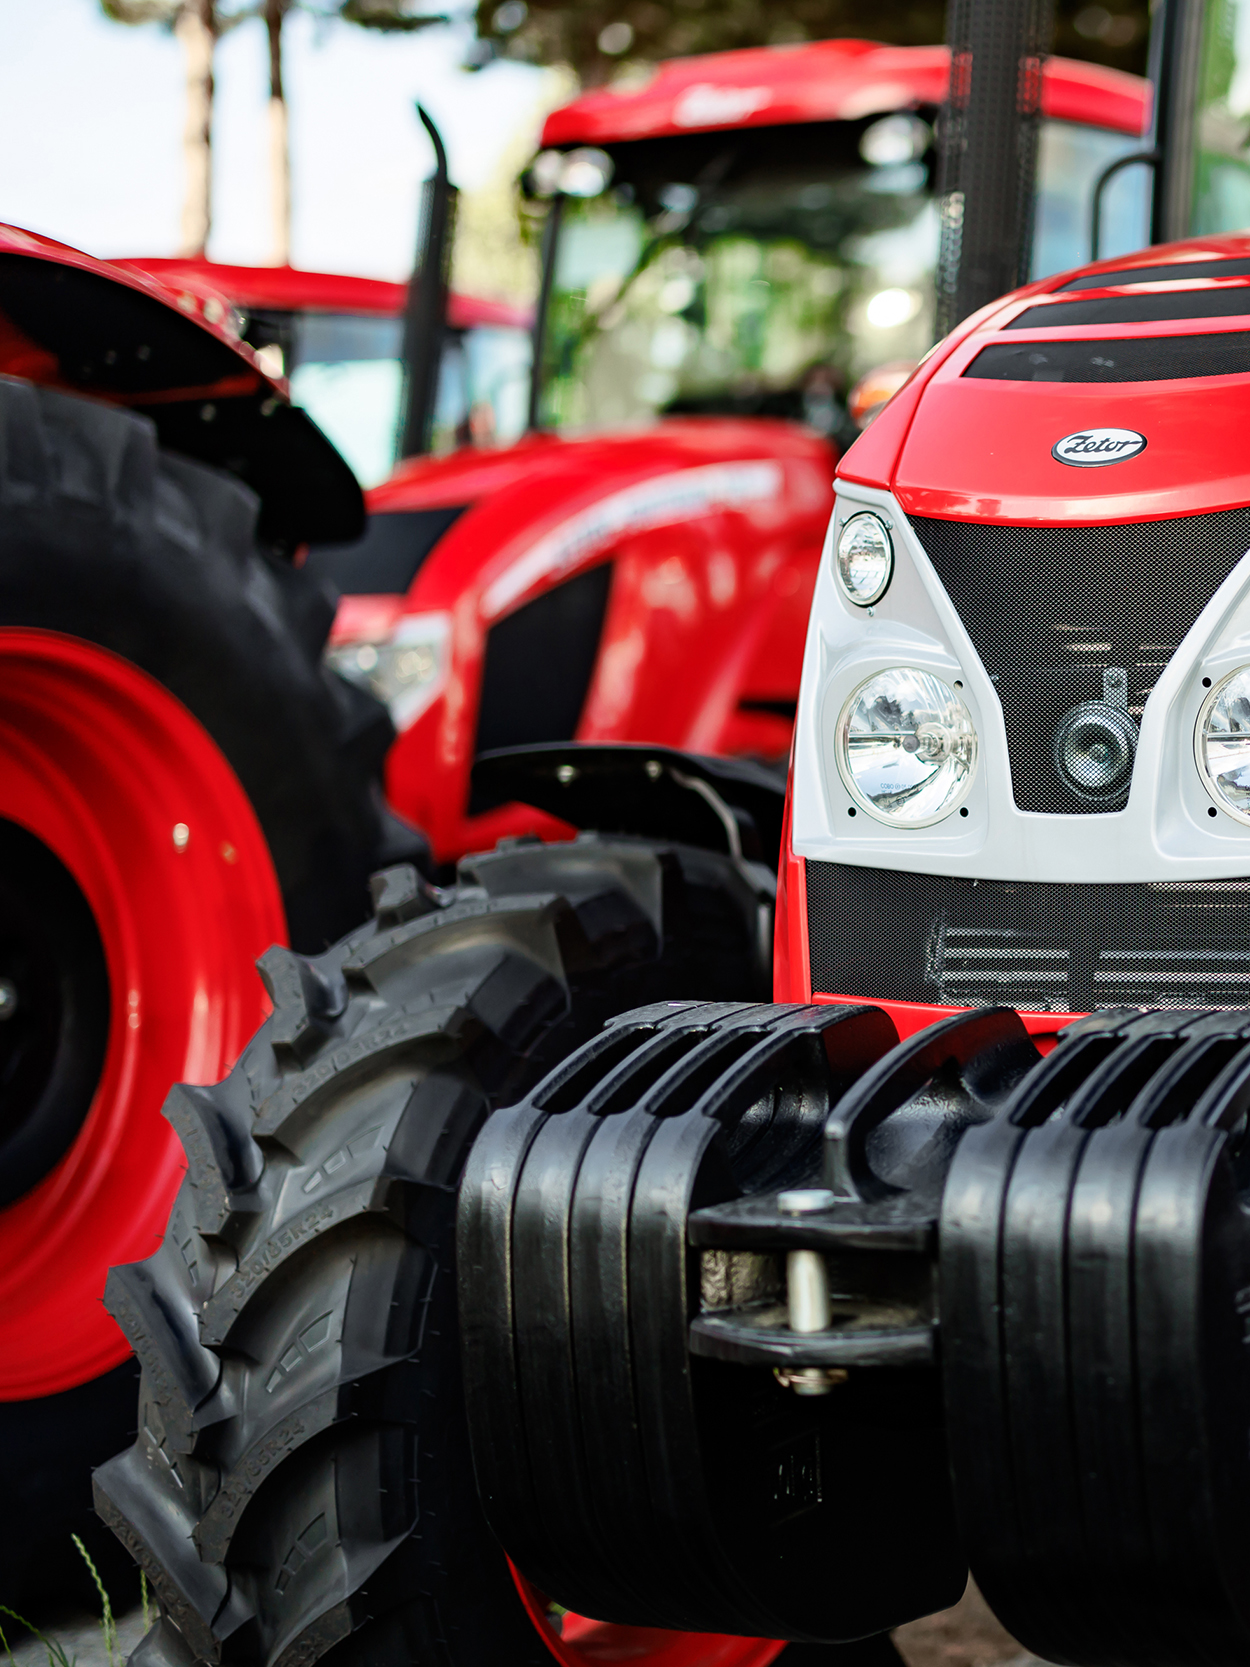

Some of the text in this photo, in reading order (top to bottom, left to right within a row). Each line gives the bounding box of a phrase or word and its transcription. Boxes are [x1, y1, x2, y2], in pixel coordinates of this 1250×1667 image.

[1063, 434, 1143, 454] Zetor
[229, 1204, 334, 1299] 320/85R24
[220, 1418, 306, 1519] 320/85R24
